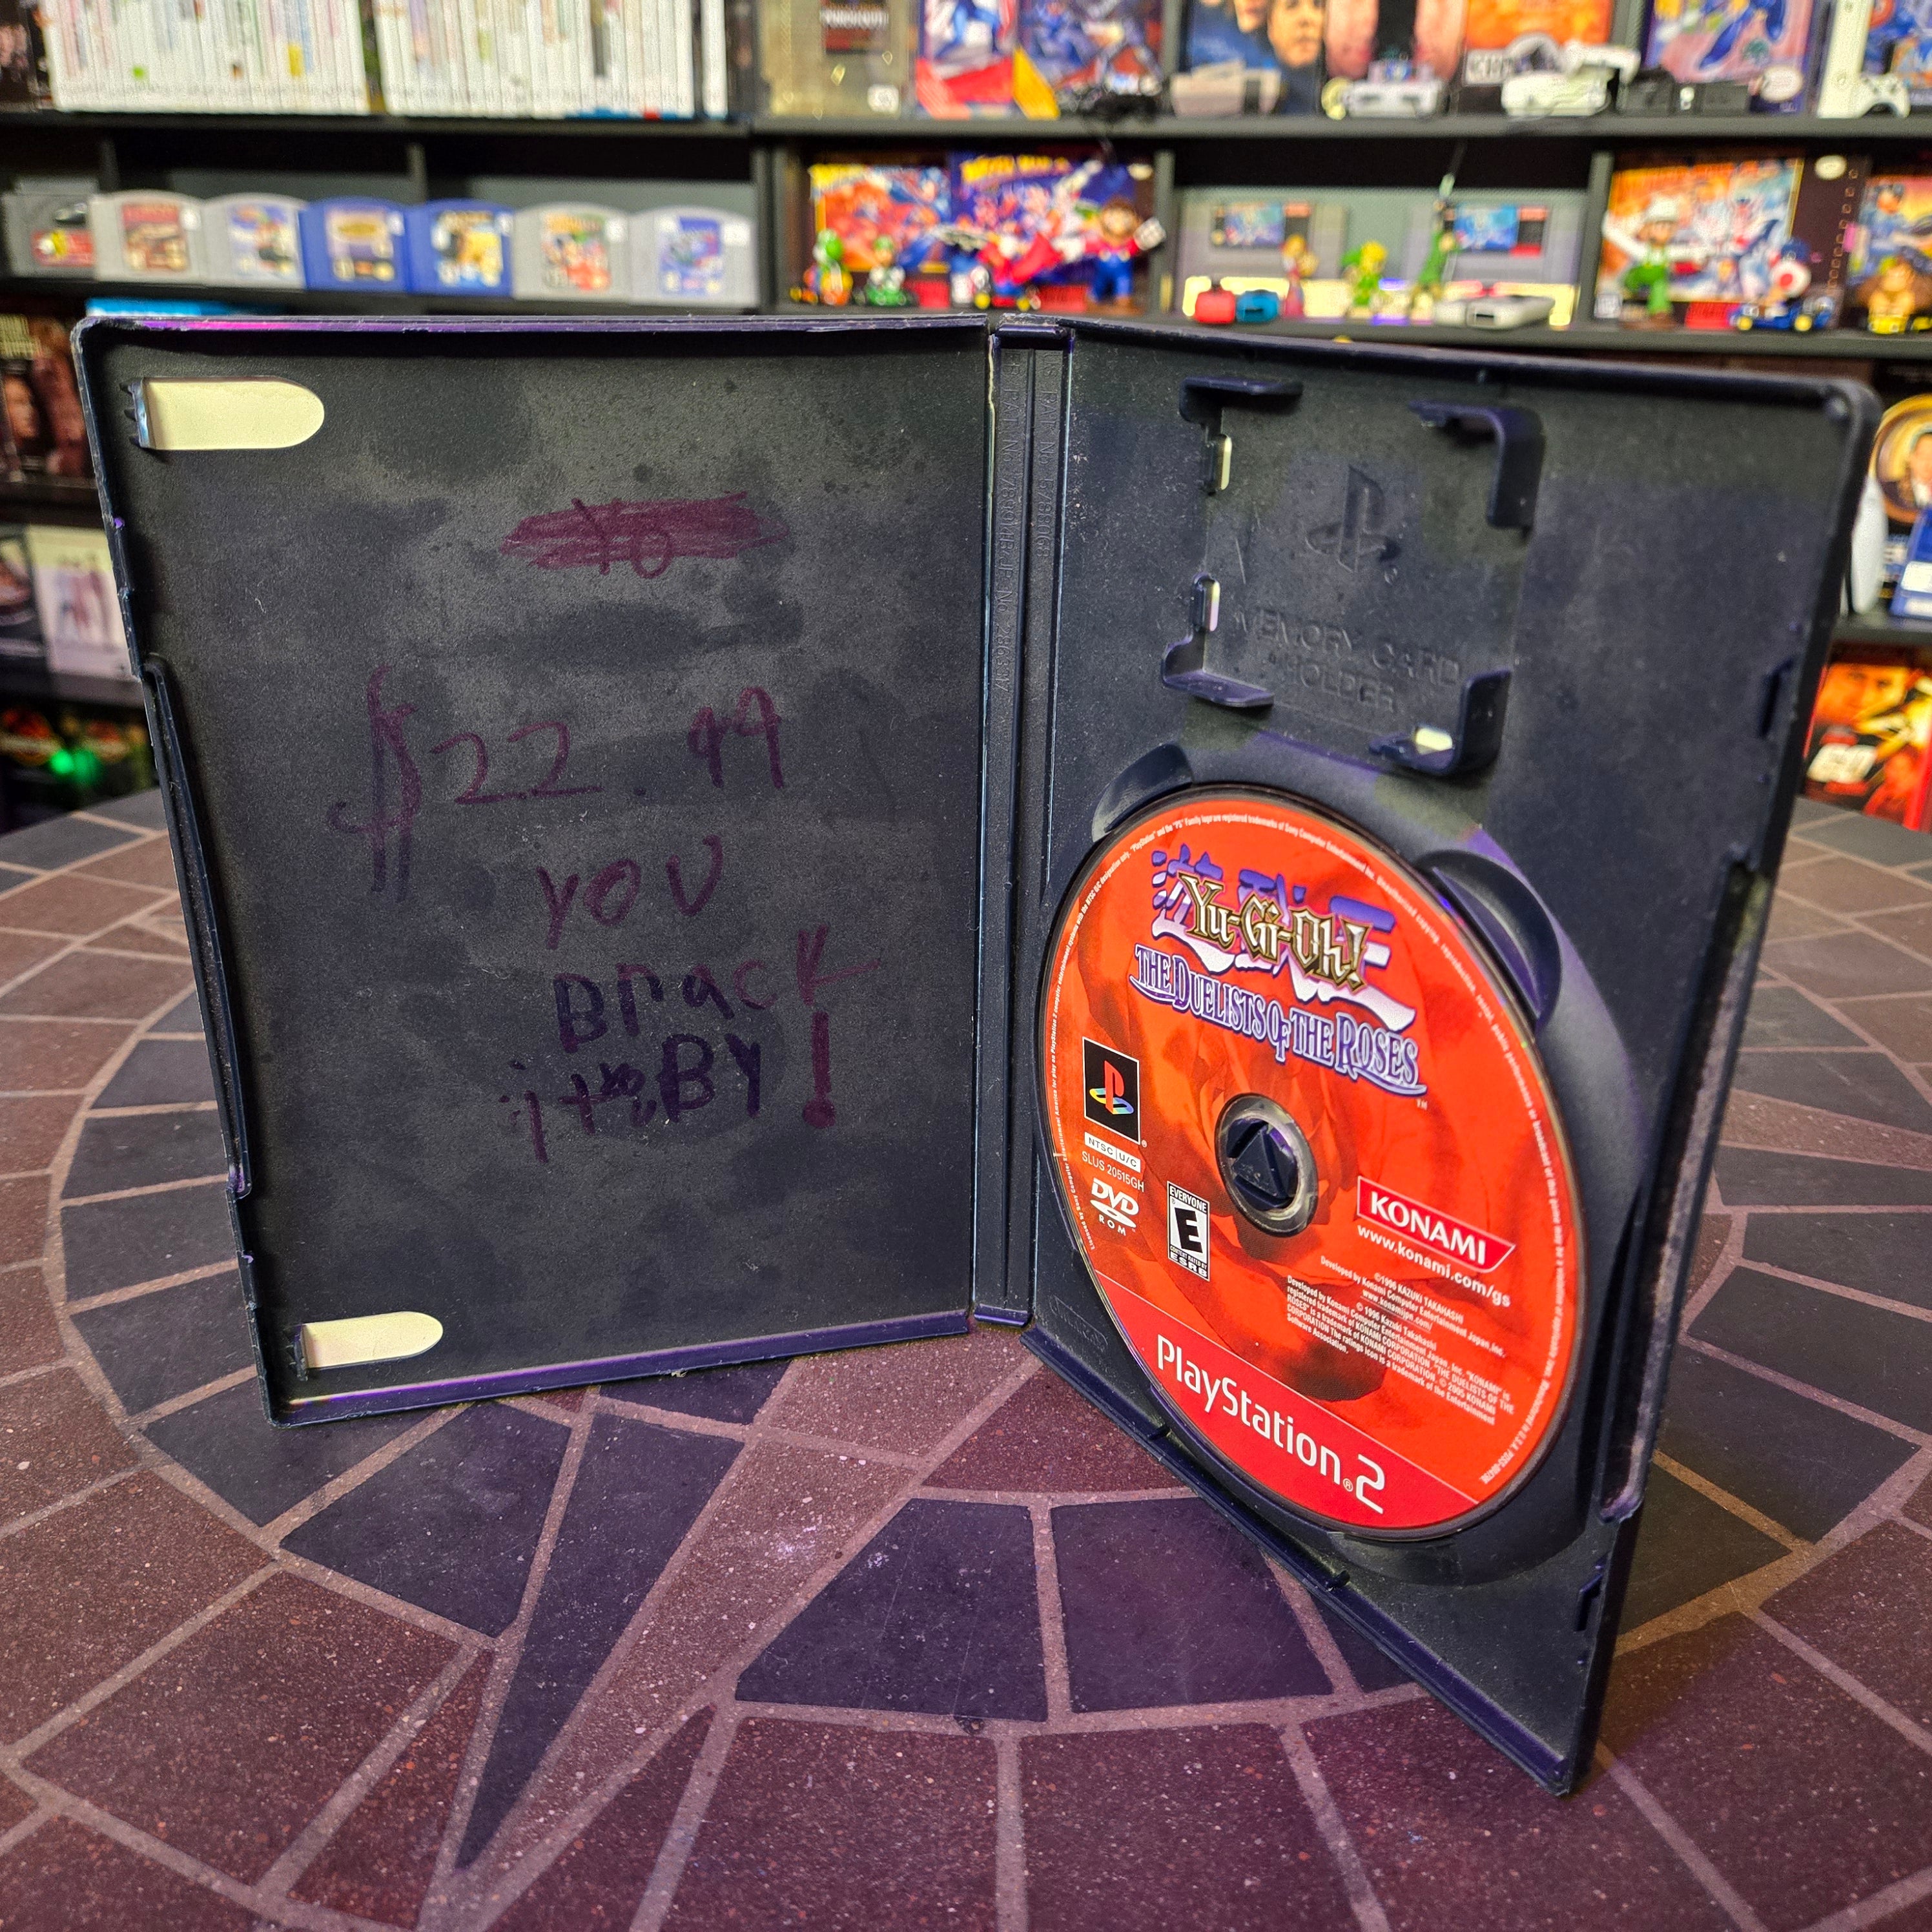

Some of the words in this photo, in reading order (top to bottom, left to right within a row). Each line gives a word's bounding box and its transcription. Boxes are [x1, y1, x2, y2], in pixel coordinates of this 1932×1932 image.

[1178, 870, 1372, 993] Yu-Gi-Oh!
[1135, 944, 1172, 998] THE
[1170, 952, 1266, 1042] DUELISTS
[1290, 1007, 1335, 1071] THE
[1335, 1012, 1420, 1091] ROSES
[1051, 1054, 1055, 1063] on
[1065, 1163, 1075, 1193] Computer
[1082, 1151, 1105, 1171] SLUS
[1107, 1164, 1144, 1193] 20515GH
[1091, 1178, 1139, 1215] DVD
[1169, 1186, 1208, 1213] EVERYONE
[1081, 1221, 1094, 1249] Licensed
[1099, 1214, 1126, 1236] ROM
[1174, 1207, 1203, 1254] E
[1370, 1190, 1486, 1265] KONAMI
[1170, 1245, 1187, 1259] CONTENT
[1187, 1253, 1201, 1265] RATED
[1202, 1260, 1208, 1269] BY
[1170, 1253, 1208, 1277] ESRB
[1357, 1225, 1512, 1308] www.konami.com/gs
[1321, 1255, 1352, 1280] Developed
[1353, 1271, 1361, 1284] by
[1362, 1276, 1386, 1297] Konami
[1387, 1289, 1419, 1314] Computer
[1419, 1305, 1467, 1339] Entertainment
[1398, 1283, 1422, 1304] KAZUKI
[1424, 1297, 1464, 1325] TAKAHASHI
[1287, 1313, 1311, 1334] Software
[1287, 1275, 1317, 1299] Developed
[1318, 1291, 1326, 1303] by
[1326, 1296, 1350, 1315] Konami
[1350, 1309, 1380, 1332] Computer
[1381, 1325, 1426, 1357] Entertainment
[1503, 1390, 1510, 1403] is
[1364, 1304, 1380, 1322] 1996
[1381, 1313, 1402, 1333] Kazuki
[1403, 1325, 1436, 1352] Takahashi
[1287, 1284, 1316, 1307] registered
[1317, 1300, 1347, 1324] trademark
[1348, 1317, 1355, 1328] of
[1355, 1321, 1381, 1343] KONAMI
[1451, 1372, 1486, 1400] DUELISTS
[1487, 1392, 1497, 1406] OF
[1499, 1397, 1514, 1415] THE
[1287, 1302, 1329, 1334] CORPORATION
[1330, 1326, 1342, 1341] The
[1342, 1333, 1364, 1353] ratings
[1364, 1346, 1378, 1361] icon
[1379, 1353, 1385, 1365] is
[1386, 1359, 1390, 1368] a
[1392, 1361, 1424, 1387] trademark
[1426, 1379, 1434, 1392] of
[1434, 1384, 1445, 1399] the
[1446, 1390, 1495, 1426] Entertainment
[1310, 1306, 1316, 1317] is
[1317, 1311, 1320, 1319] a
[1321, 1311, 1352, 1337] trademark
[1353, 1329, 1359, 1341] of
[1360, 1333, 1386, 1355] KONAMI
[1466, 1390, 1495, 1416] KONAMI
